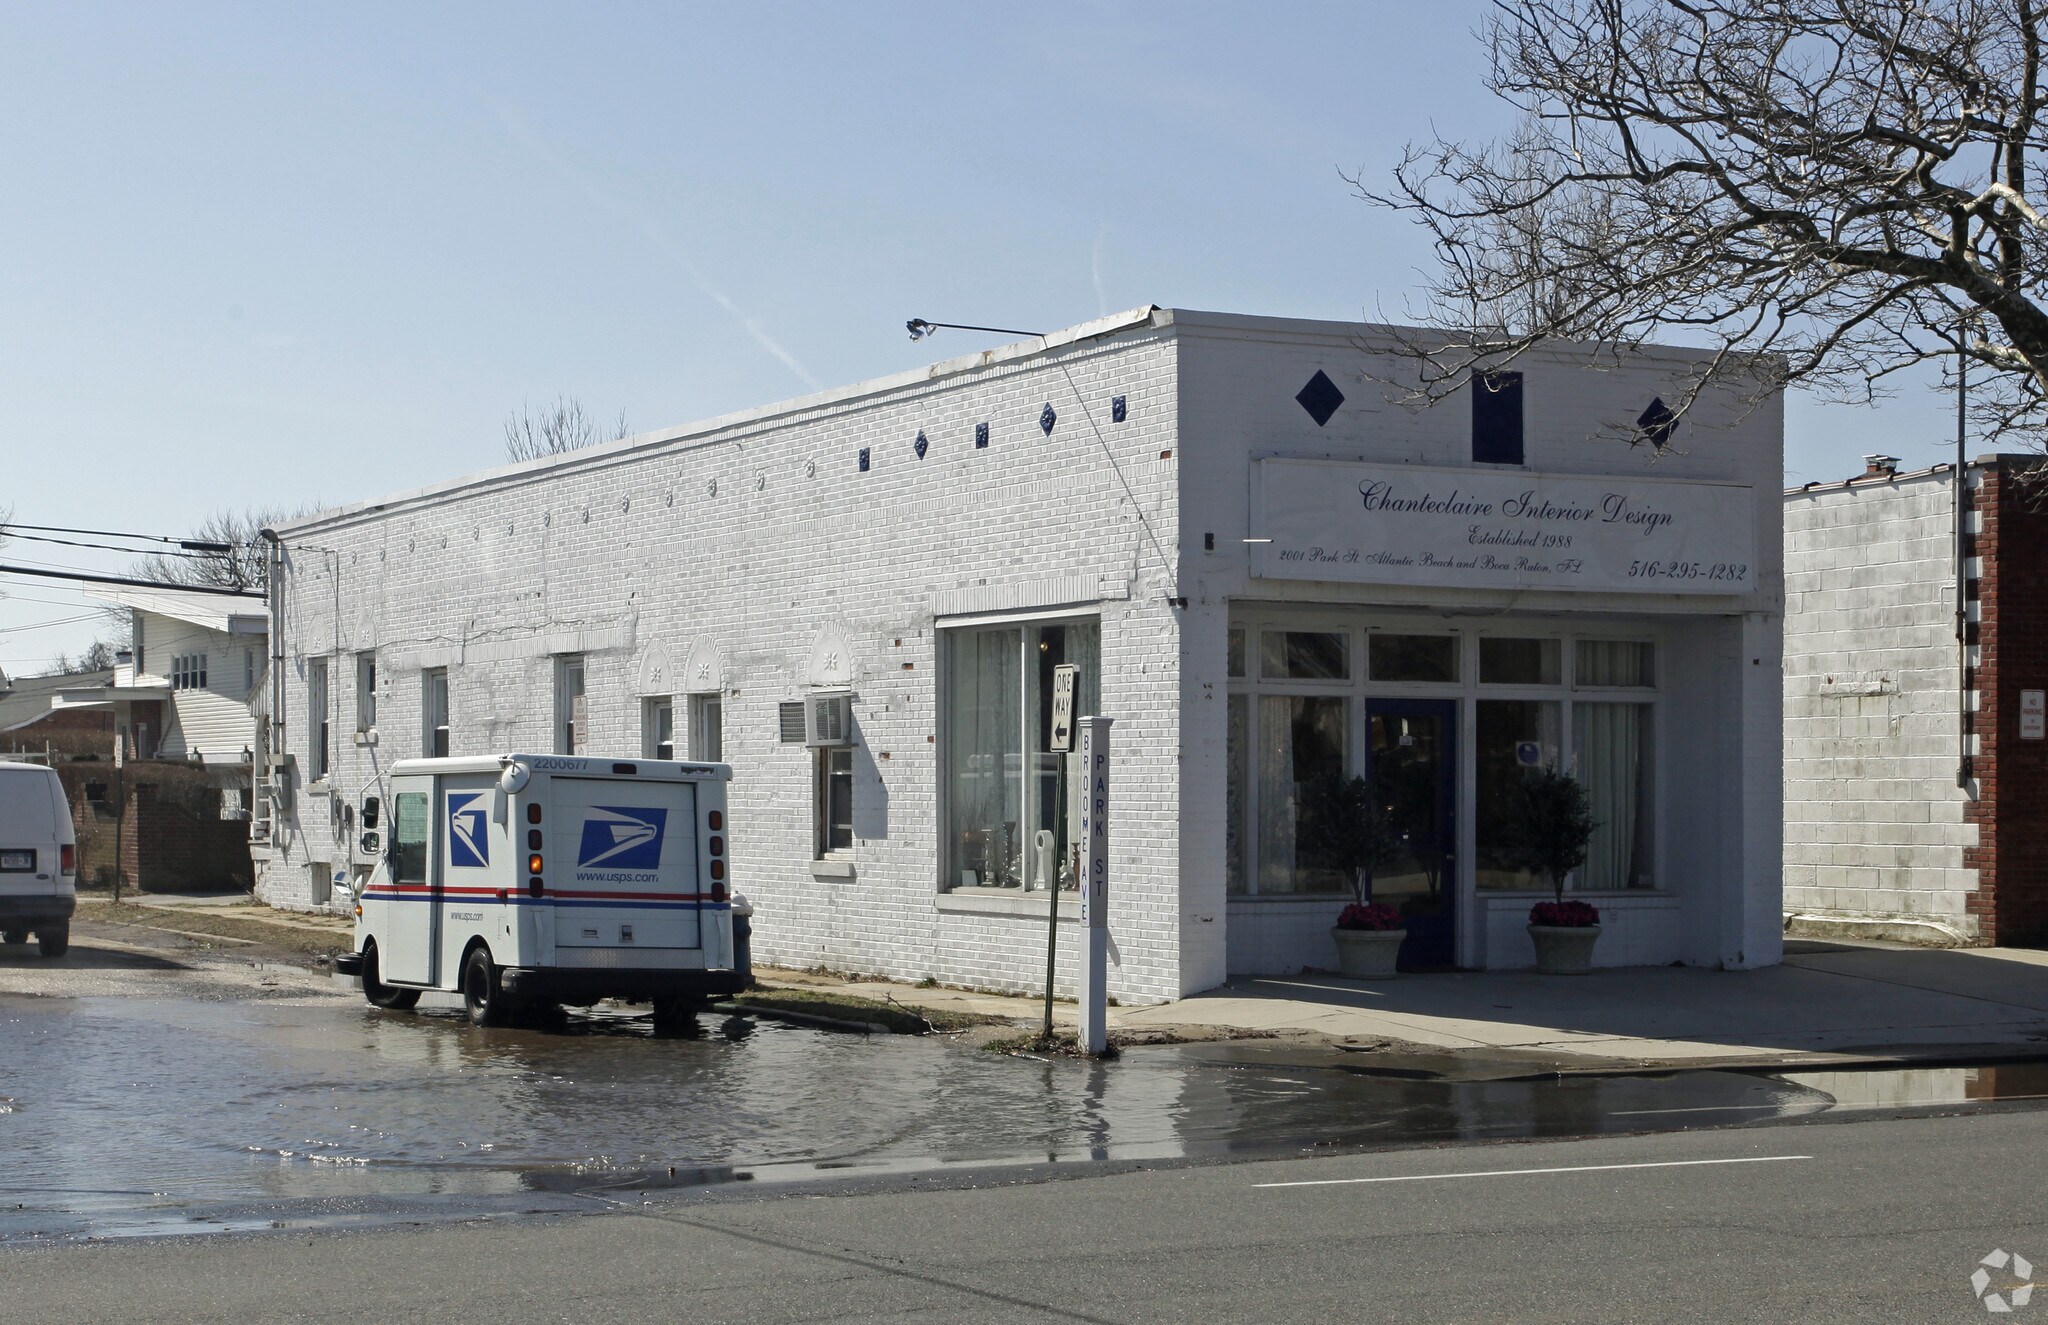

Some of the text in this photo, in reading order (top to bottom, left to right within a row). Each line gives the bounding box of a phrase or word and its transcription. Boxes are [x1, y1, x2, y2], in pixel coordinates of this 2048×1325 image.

[1358, 479, 1673, 536] Chanteclaire Interior Design
[1467, 524, 1573, 549] Established 1988
[1279, 549, 1306, 561] 2001
[1308, 546, 1339, 563] Park
[1365, 550, 1414, 566] Atlantic
[1418, 551, 1454, 569] Beach
[1456, 556, 1479, 569] and
[1480, 554, 1510, 571] Boca
[1513, 556, 1553, 574] Raton,
[1556, 558, 1584, 574] FL
[1628, 560, 1748, 581] 516-295-1282
[1056, 673, 1072, 693] ONE
[1055, 696, 1071, 717] WAY
[533, 758, 589, 771] 2200677
[1095, 754, 1104, 898] PARK ST
[576, 872, 659, 884] www.usps.com
